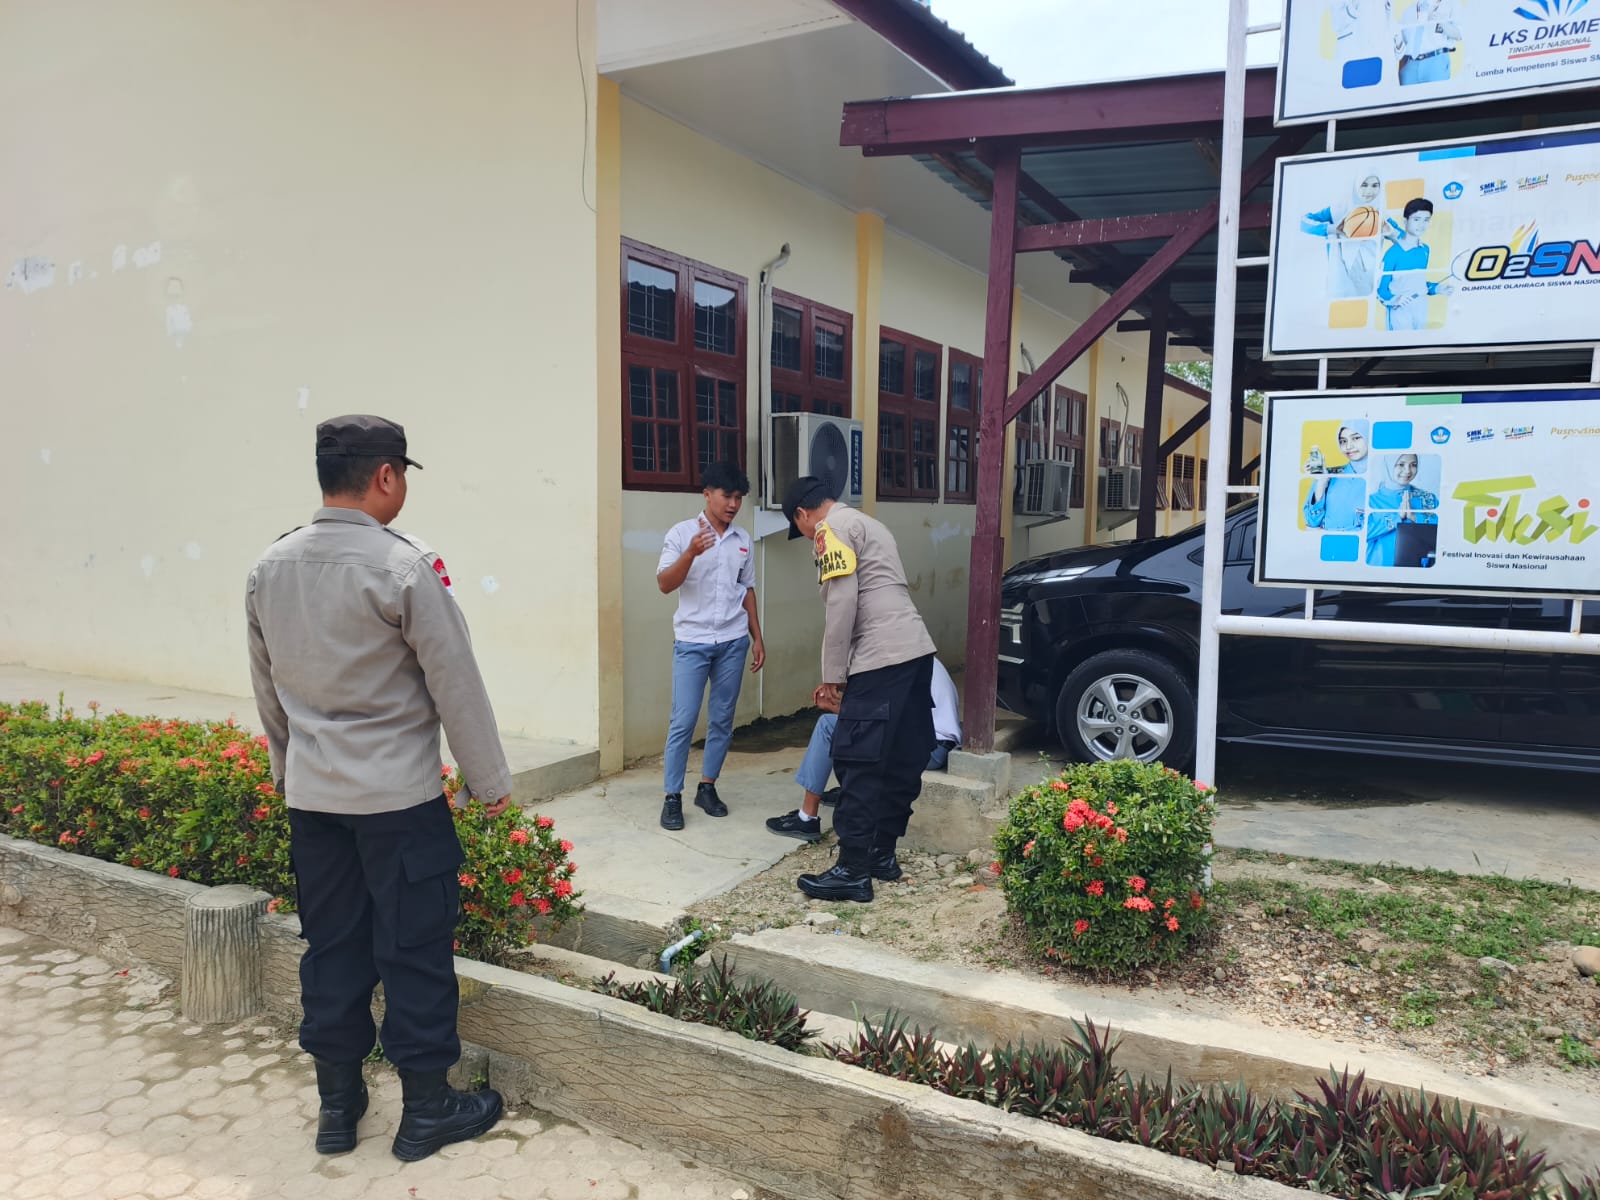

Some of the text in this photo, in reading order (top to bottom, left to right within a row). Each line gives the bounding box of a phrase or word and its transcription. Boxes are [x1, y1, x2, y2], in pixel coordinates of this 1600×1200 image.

[1489, 17, 1600, 47] LKS DIKME
[1509, 36, 1592, 54] TINGKAT NASIONAL
[1475, 68, 1504, 78] Lomba
[1506, 60, 1558, 74] Kompetensi
[1560, 56, 1588, 66] Siswa
[1461, 278, 1600, 292] OLIMPIADE OLAHRAGA SISWA NASIO
[1442, 551, 1473, 559] Festival
[1474, 552, 1503, 560] Inovasi
[1522, 553, 1586, 561] Kewirausahaan
[1486, 561, 1548, 570] Siswa Nasional
